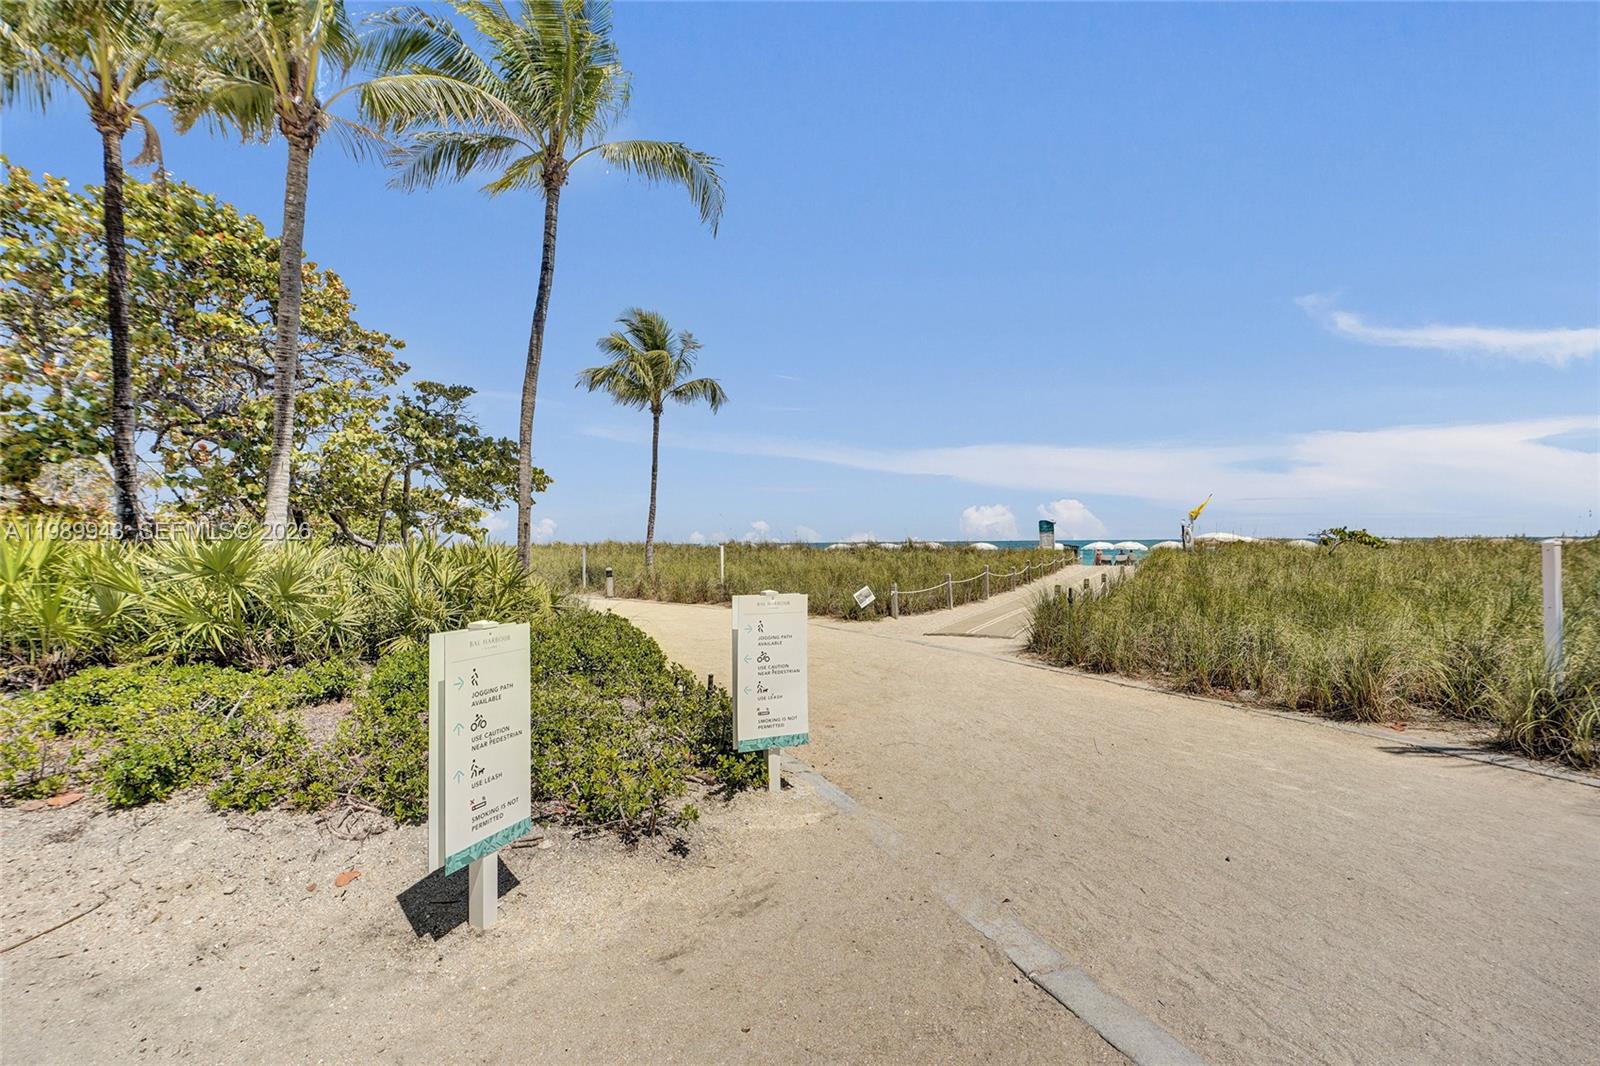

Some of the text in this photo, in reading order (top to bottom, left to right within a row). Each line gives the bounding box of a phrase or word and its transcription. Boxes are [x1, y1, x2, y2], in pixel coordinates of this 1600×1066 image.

[471, 683, 514, 699] JOGGING PATH
[471, 694, 502, 707] AVAILABLE
[471, 726, 510, 743] USE CAUTION
[471, 729, 523, 752] NEAR PEDESTRIAN
[471, 772, 503, 789] USE LEASH
[471, 797, 520, 824] SMOKING IS NOT
[471, 812, 504, 832] PERMITTED
